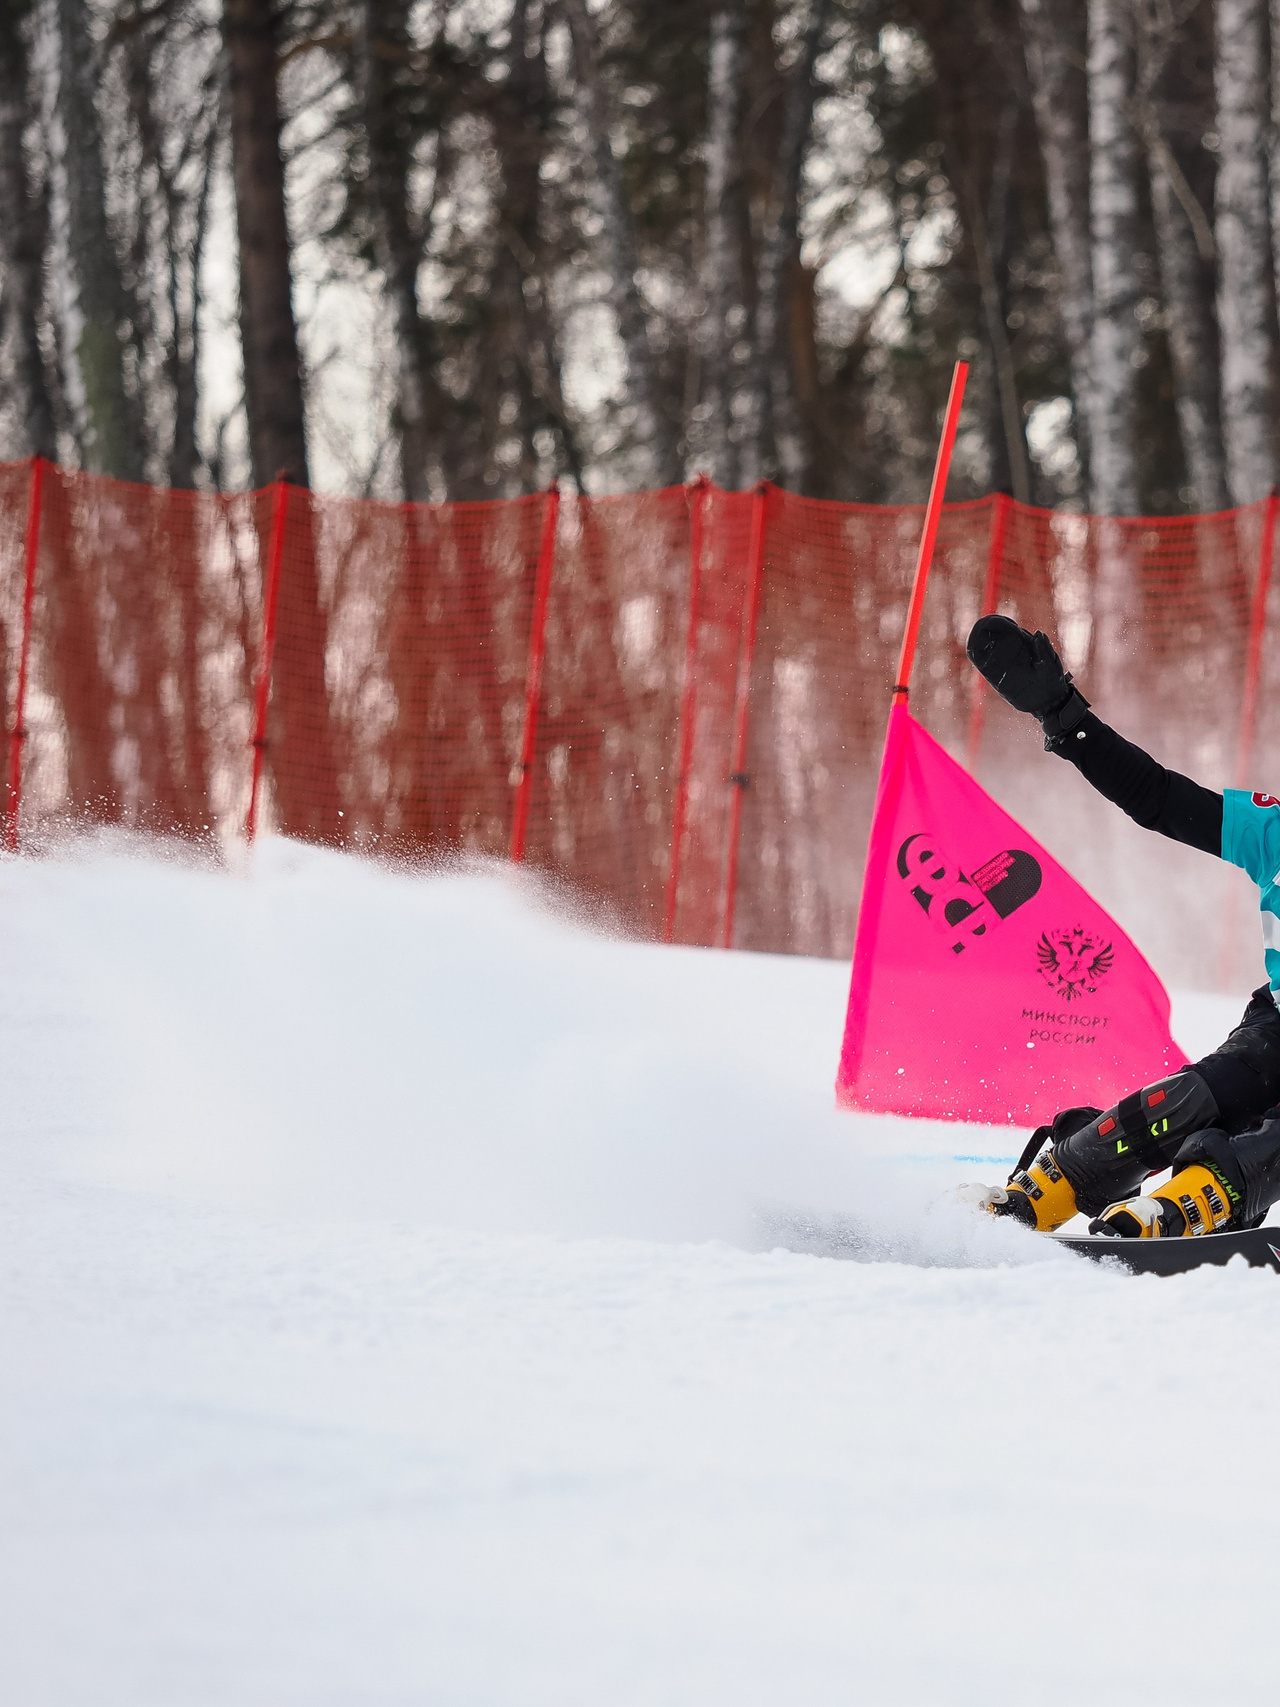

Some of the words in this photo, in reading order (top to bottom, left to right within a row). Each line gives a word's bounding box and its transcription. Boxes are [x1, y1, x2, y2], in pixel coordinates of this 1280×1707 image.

[1021, 1008, 1109, 1028] МИНСПОРТ
[1029, 1029, 1096, 1045] РОССИИ
[1116, 1117, 1169, 1154] LKI
